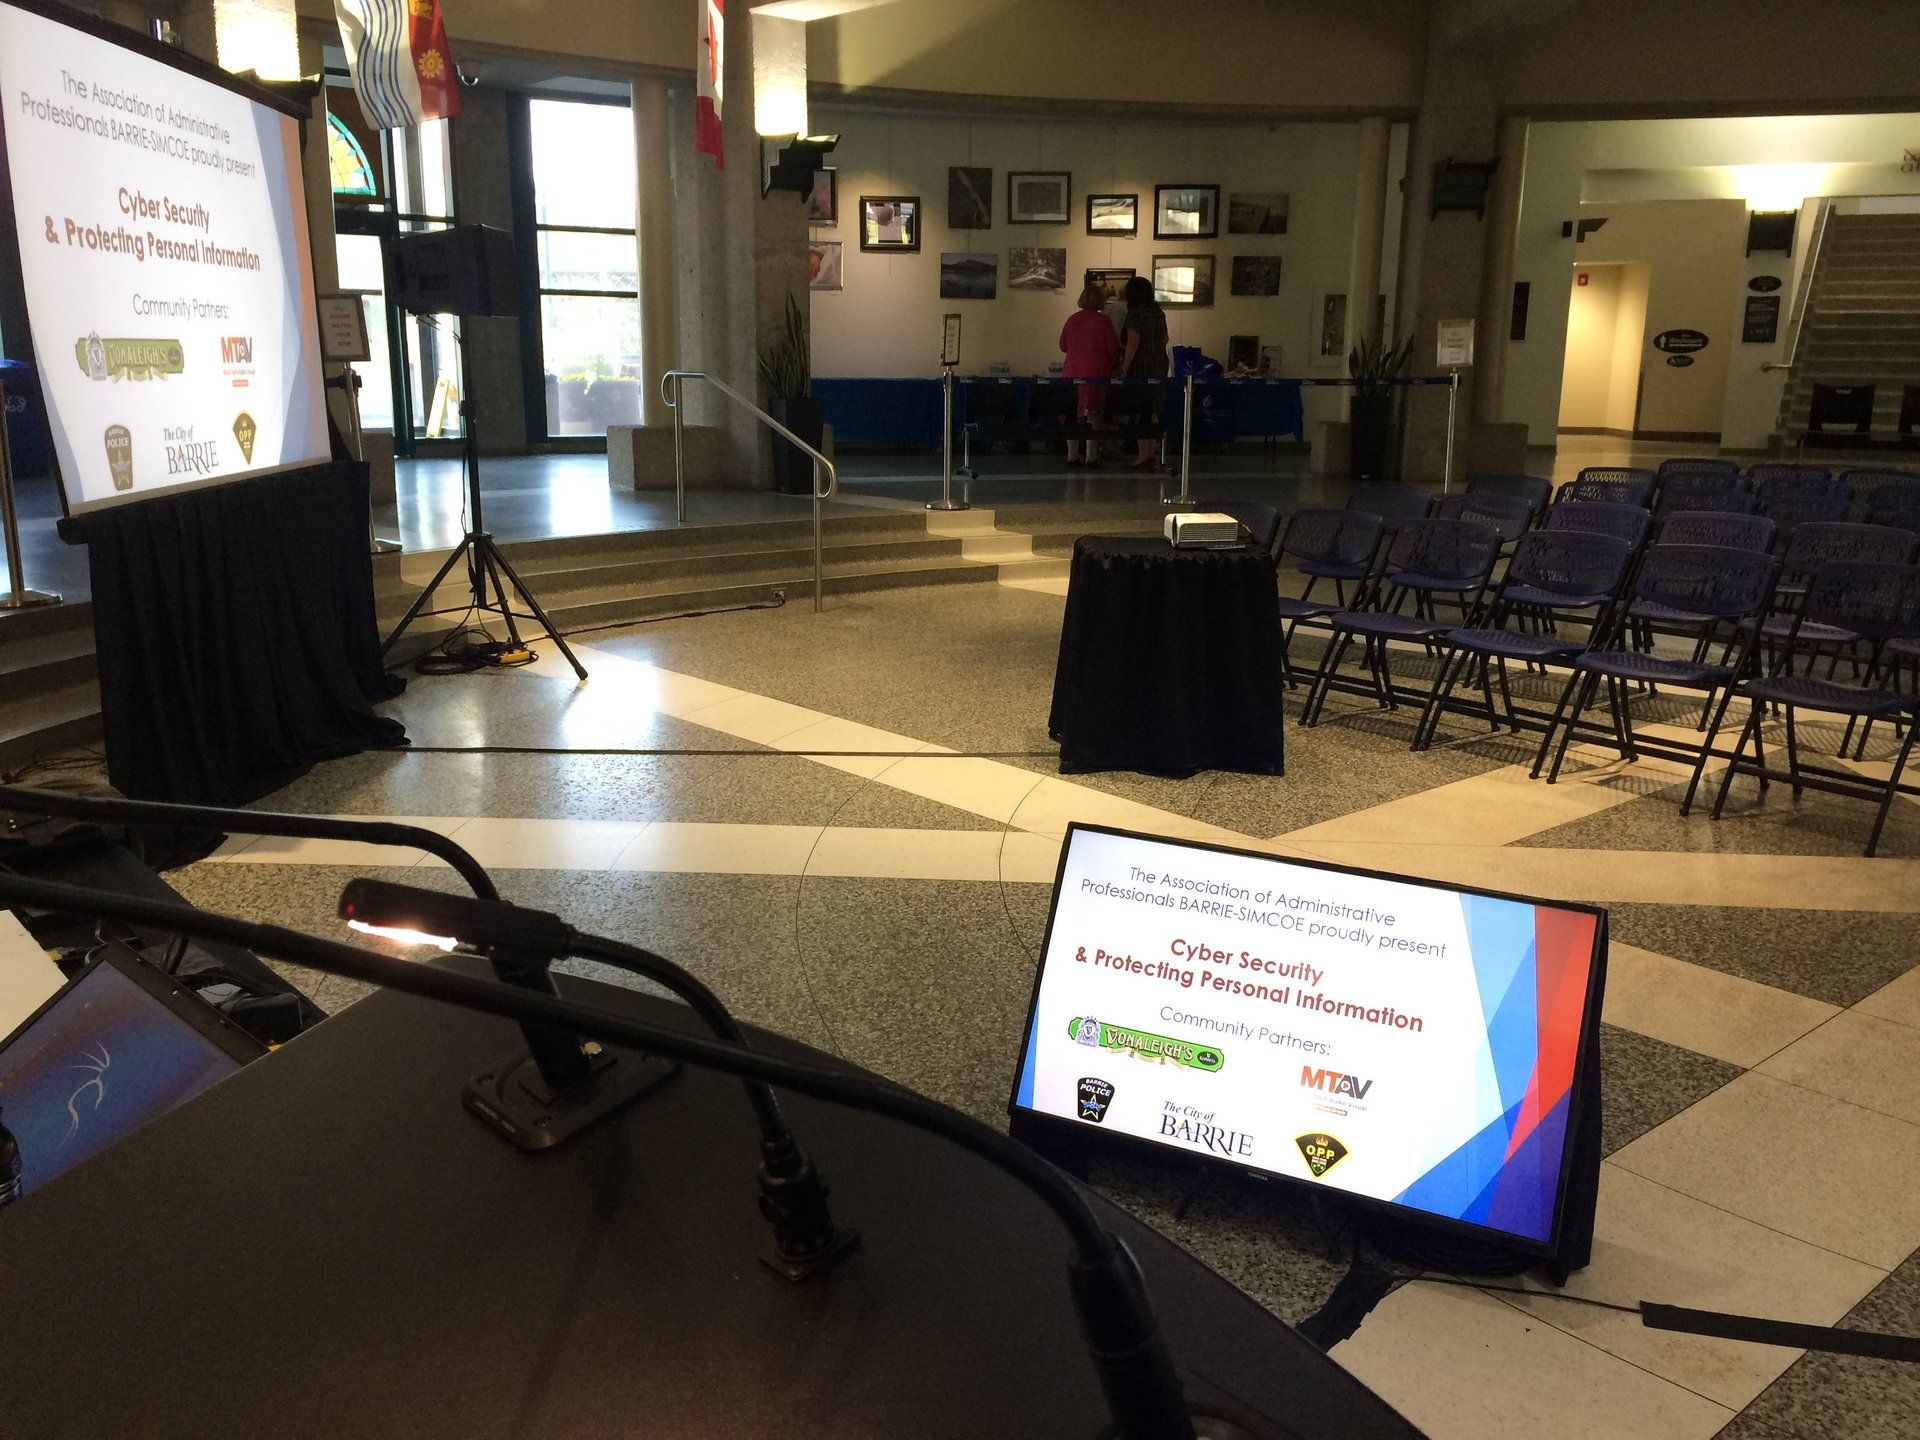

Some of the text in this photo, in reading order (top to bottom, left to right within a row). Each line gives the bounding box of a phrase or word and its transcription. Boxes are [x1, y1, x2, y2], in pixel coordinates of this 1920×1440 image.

[61, 70, 230, 144] The Association of Administrative
[21, 91, 256, 179] Professionals BARRIE-SIMCOE proudly present
[118, 187, 210, 234] Cyber Security
[44, 215, 261, 271] & Protecting Personal Information
[132, 294, 230, 321] Community Partners:
[107, 437, 129, 448] POLICE
[163, 427, 175, 441] The
[175, 426, 187, 441] City
[165, 440, 219, 475] BARRIE
[1081, 878, 1448, 959] Professionals BARRIE-SIMCOE proudly present
[1130, 866, 1396, 927] The Association of Administrative
[1170, 938, 1325, 987] Cyber Security
[1075, 946, 1424, 1033] & Protecting Personal Information
[1159, 1005, 1332, 1057] Community Partners:
[1080, 1083, 1112, 1097] POLICE
[1085, 1078, 1109, 1089] BARRIE
[1300, 1065, 1374, 1101] MTAV
[1164, 1100, 1217, 1123] The City of
[1158, 1113, 1254, 1157] BARRIE
